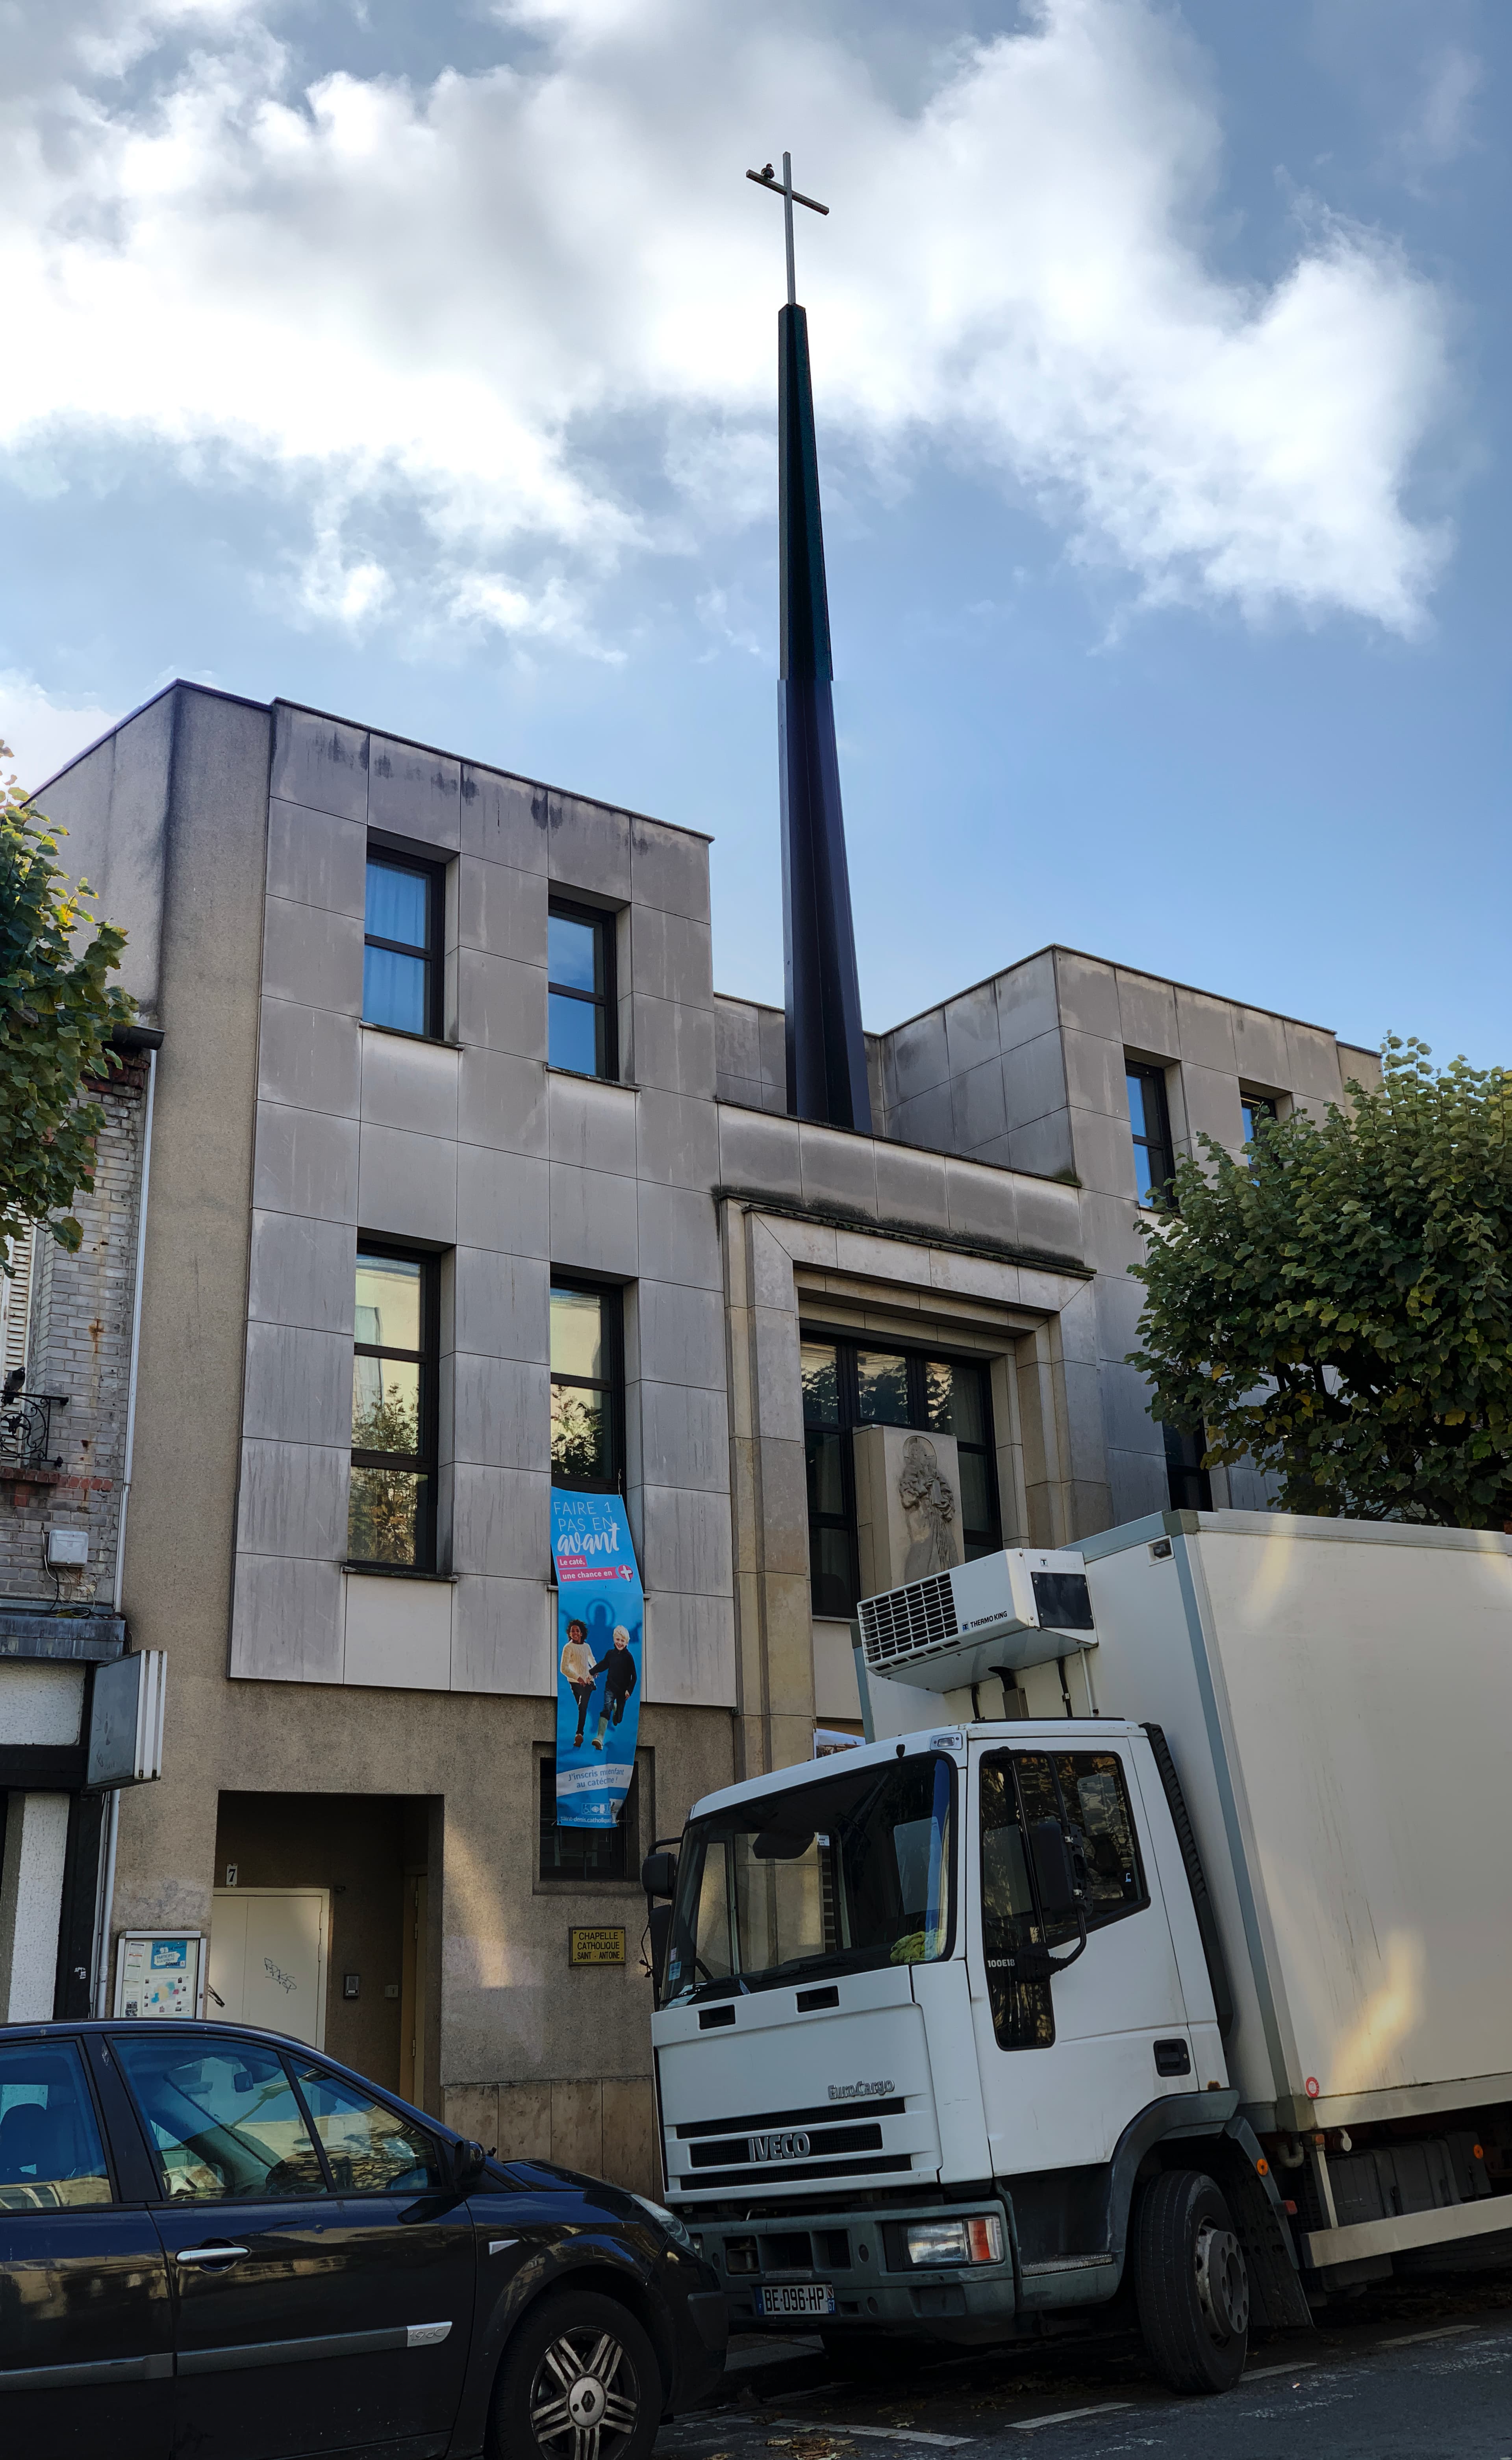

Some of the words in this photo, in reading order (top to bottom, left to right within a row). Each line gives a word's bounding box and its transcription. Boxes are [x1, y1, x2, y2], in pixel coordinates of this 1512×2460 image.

[554, 1502, 597, 1515] FAIRE
[604, 1502, 612, 1513] 1
[558, 1518, 586, 1531] PAS
[592, 1515, 613, 1531] EN
[558, 1523, 621, 1556] avant
[577, 1570, 602, 1578] chance
[970, 1615, 993, 1628] THERMO
[994, 1611, 1008, 1620] KING
[568, 1770, 598, 1781] J'inscris
[228, 1869, 236, 1882] 7
[578, 1932, 618, 1940] CHAPELLE
[577, 1942, 620, 1950] CATHOLIQUE
[599, 1951, 620, 1959] ANTOINE
[987, 1959, 1015, 1967] 100E18
[828, 2080, 895, 2100] EuroCargo
[748, 2132, 810, 2162] IVECO
[764, 2287, 825, 2312] BE-096-HP
[828, 2300, 835, 2311] 67
